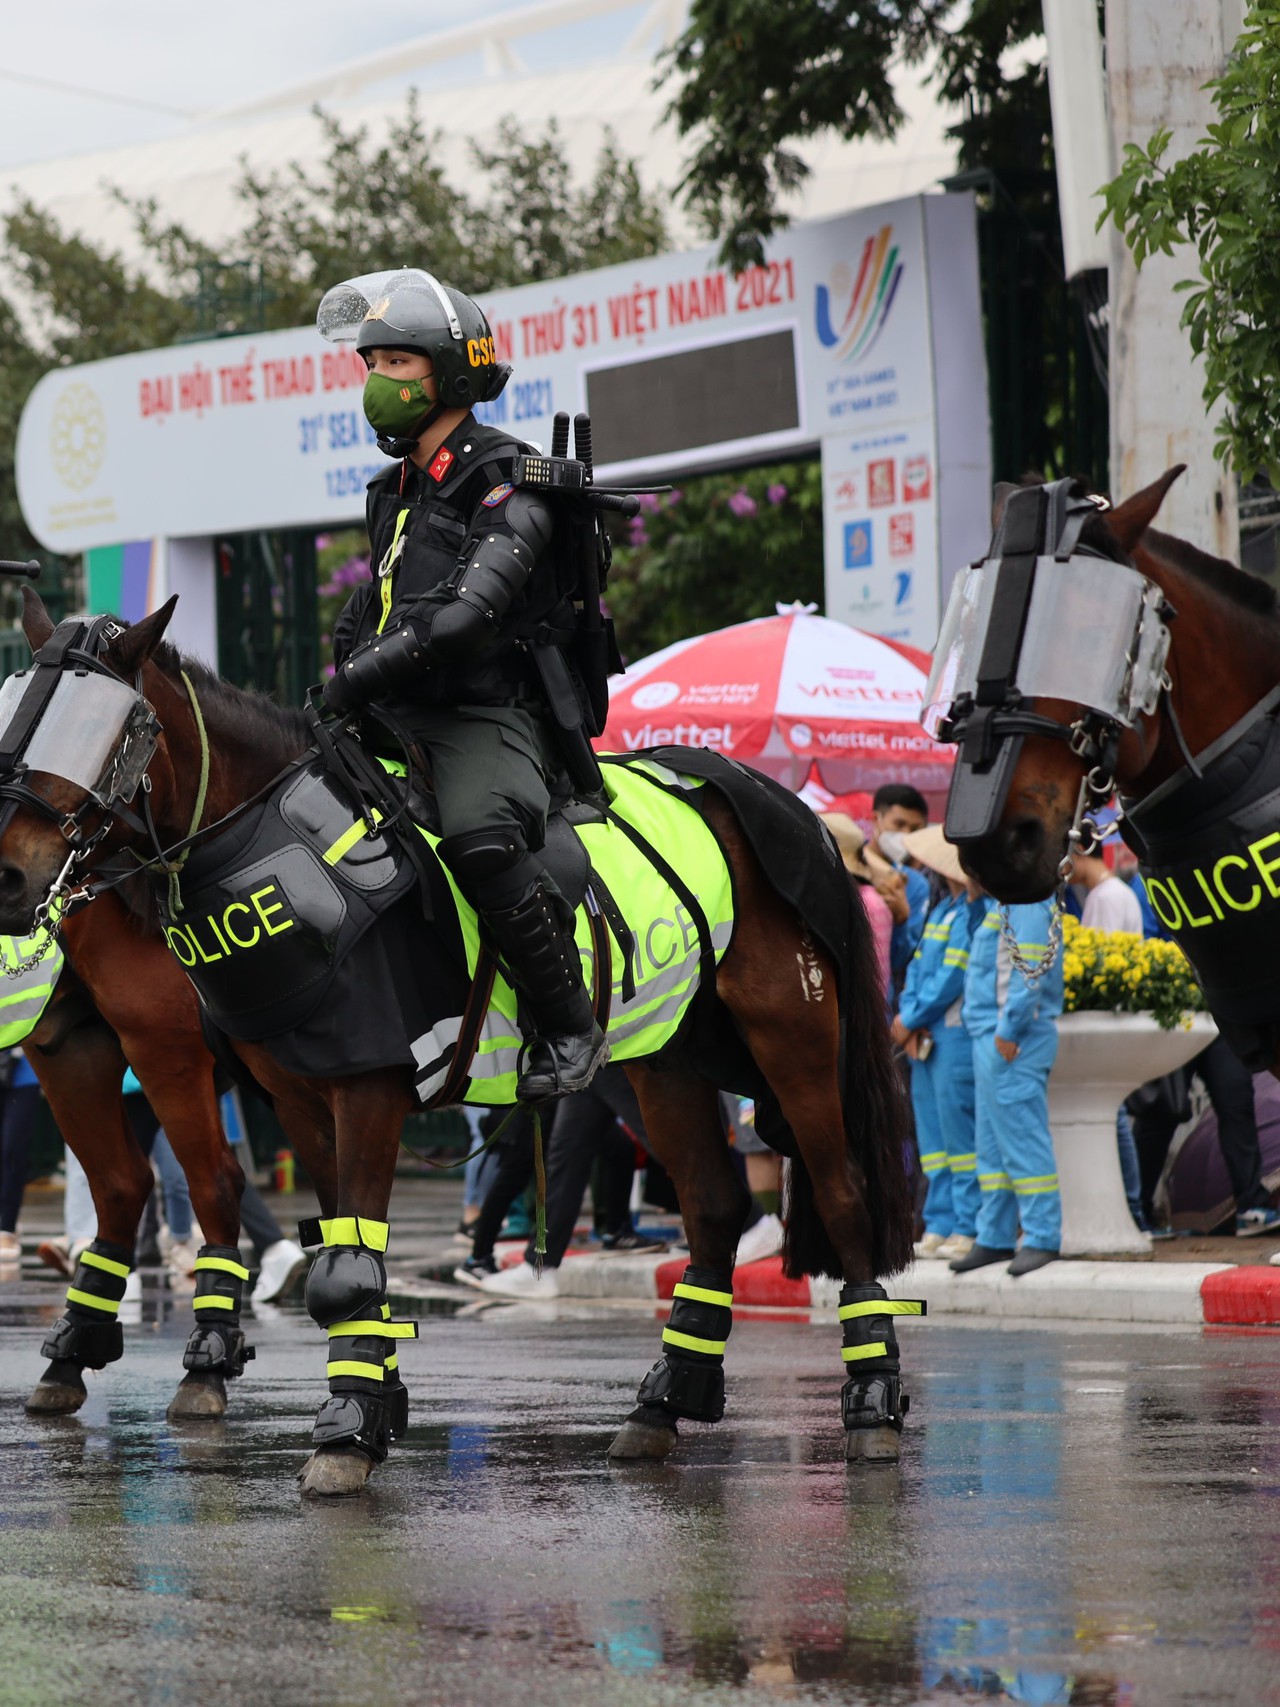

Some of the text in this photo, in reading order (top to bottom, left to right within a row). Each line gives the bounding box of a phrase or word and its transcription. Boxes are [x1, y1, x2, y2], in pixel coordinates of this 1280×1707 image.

[572, 303, 598, 349] 31
[608, 280, 658, 345] VIỆT
[667, 271, 727, 328] NAM
[735, 256, 796, 313] 2021
[261, 353, 315, 402] THAO
[322, 343, 367, 393] ĐÔN
[328, 410, 359, 450] SEA
[621, 722, 735, 750] viettel
[817, 729, 888, 750] viettel
[1138, 831, 1280, 931] OLICE
[160, 884, 294, 967] OLICE
